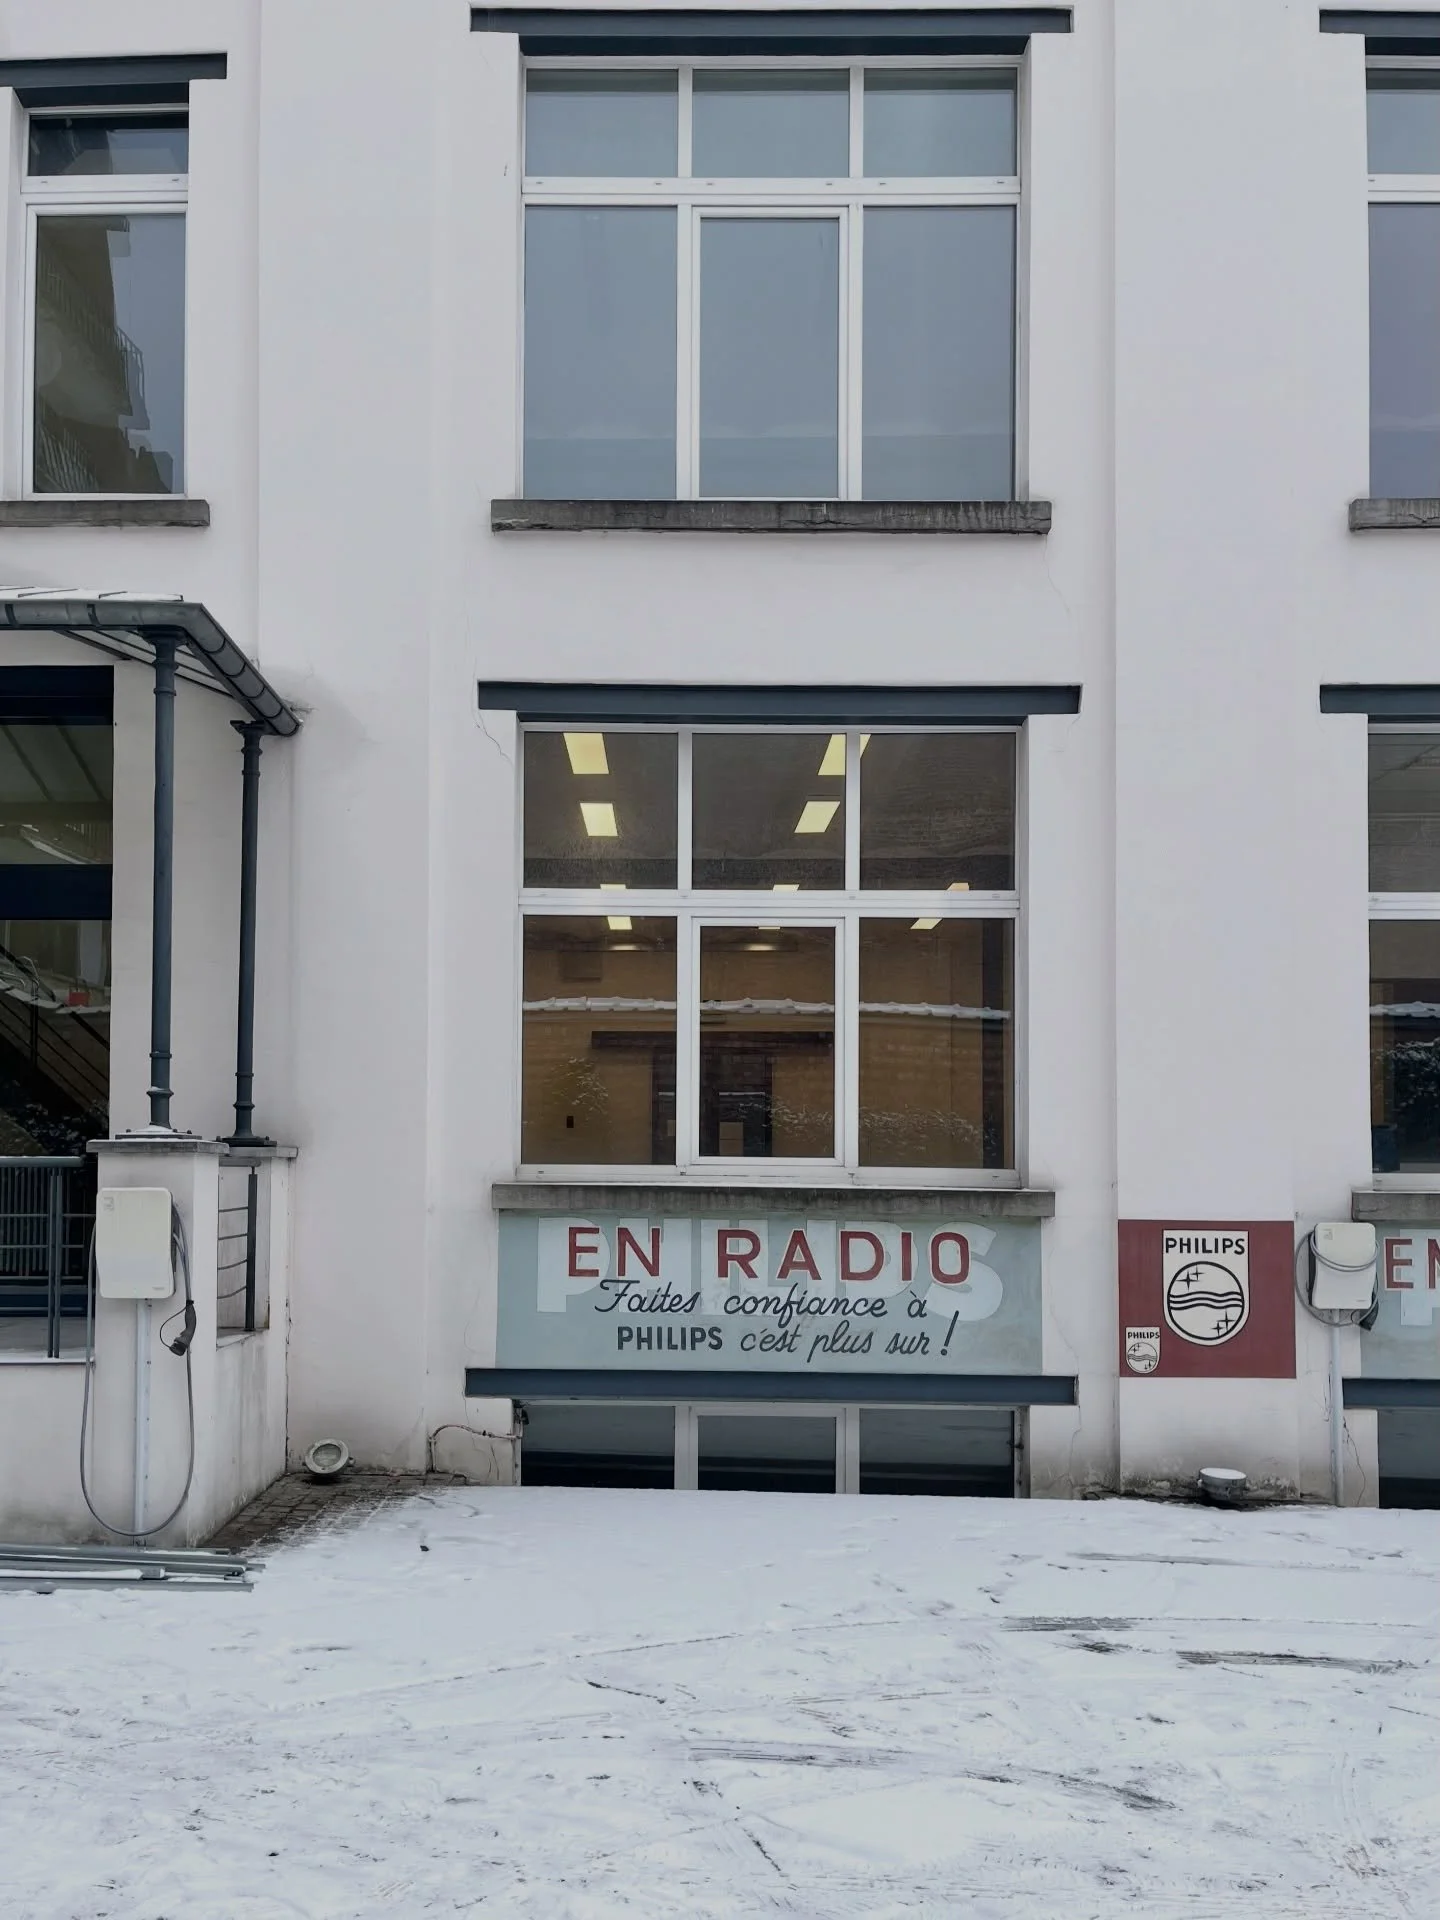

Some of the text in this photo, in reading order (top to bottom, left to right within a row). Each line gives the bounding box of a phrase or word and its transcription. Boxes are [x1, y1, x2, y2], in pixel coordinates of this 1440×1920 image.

[568, 1226, 970, 1285] EN RADIO
[1165, 1237, 1246, 1256] PHILIPS
[594, 1279, 927, 1328] Faites confiance à
[617, 1326, 723, 1350] PHILIPS
[806, 1319, 873, 1363] plus
[1127, 1331, 1160, 1339] PHILIPS
